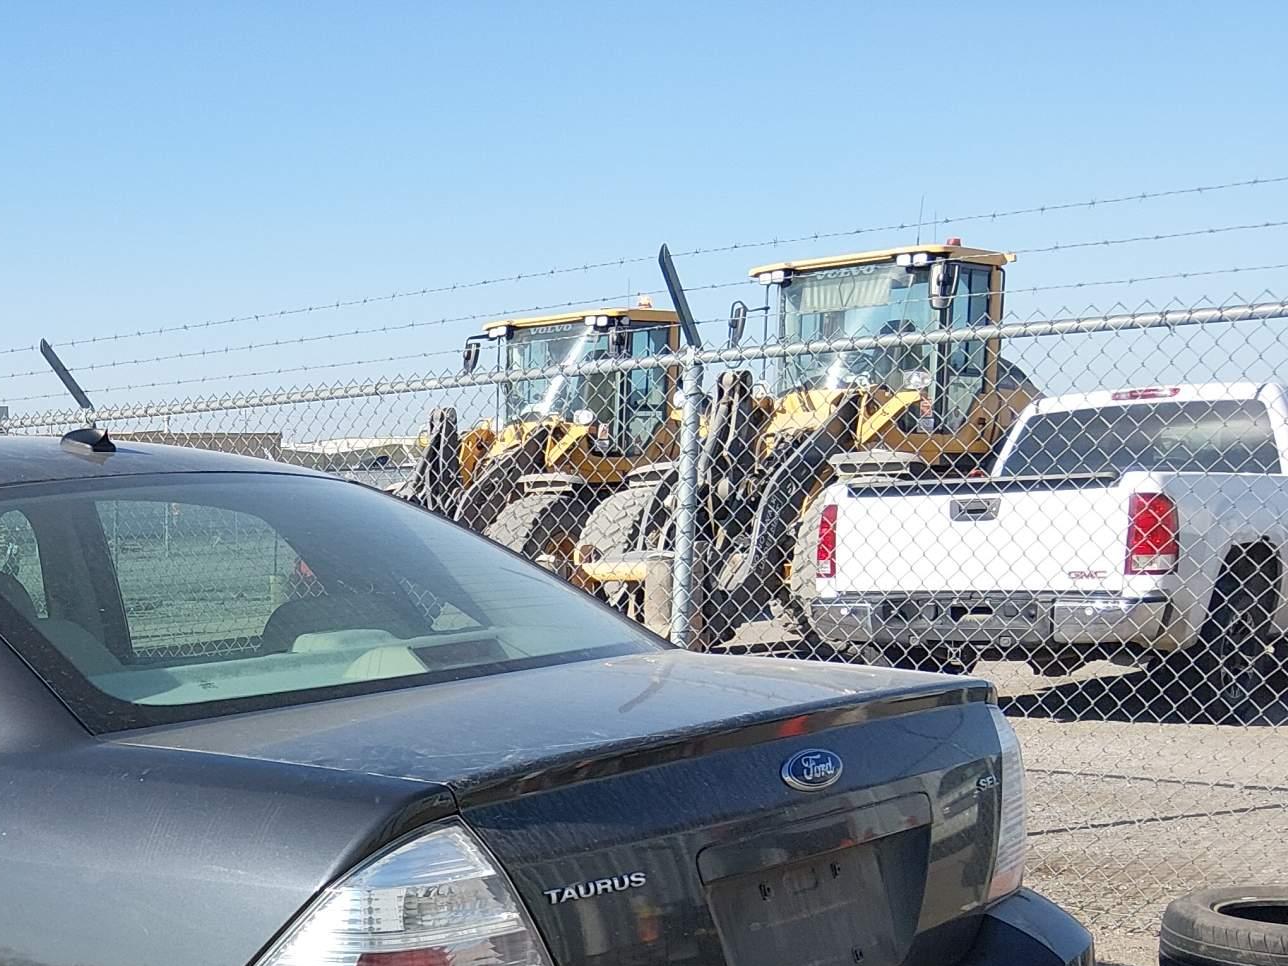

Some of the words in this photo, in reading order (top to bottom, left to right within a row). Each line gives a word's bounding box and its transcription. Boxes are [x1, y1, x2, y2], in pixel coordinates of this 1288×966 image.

[815, 264, 876, 281] VOLVO
[530, 324, 572, 336] VOLVO
[1068, 571, 1108, 580] GMC
[801, 754, 835, 780] Ford
[543, 872, 646, 905] TAURUS
